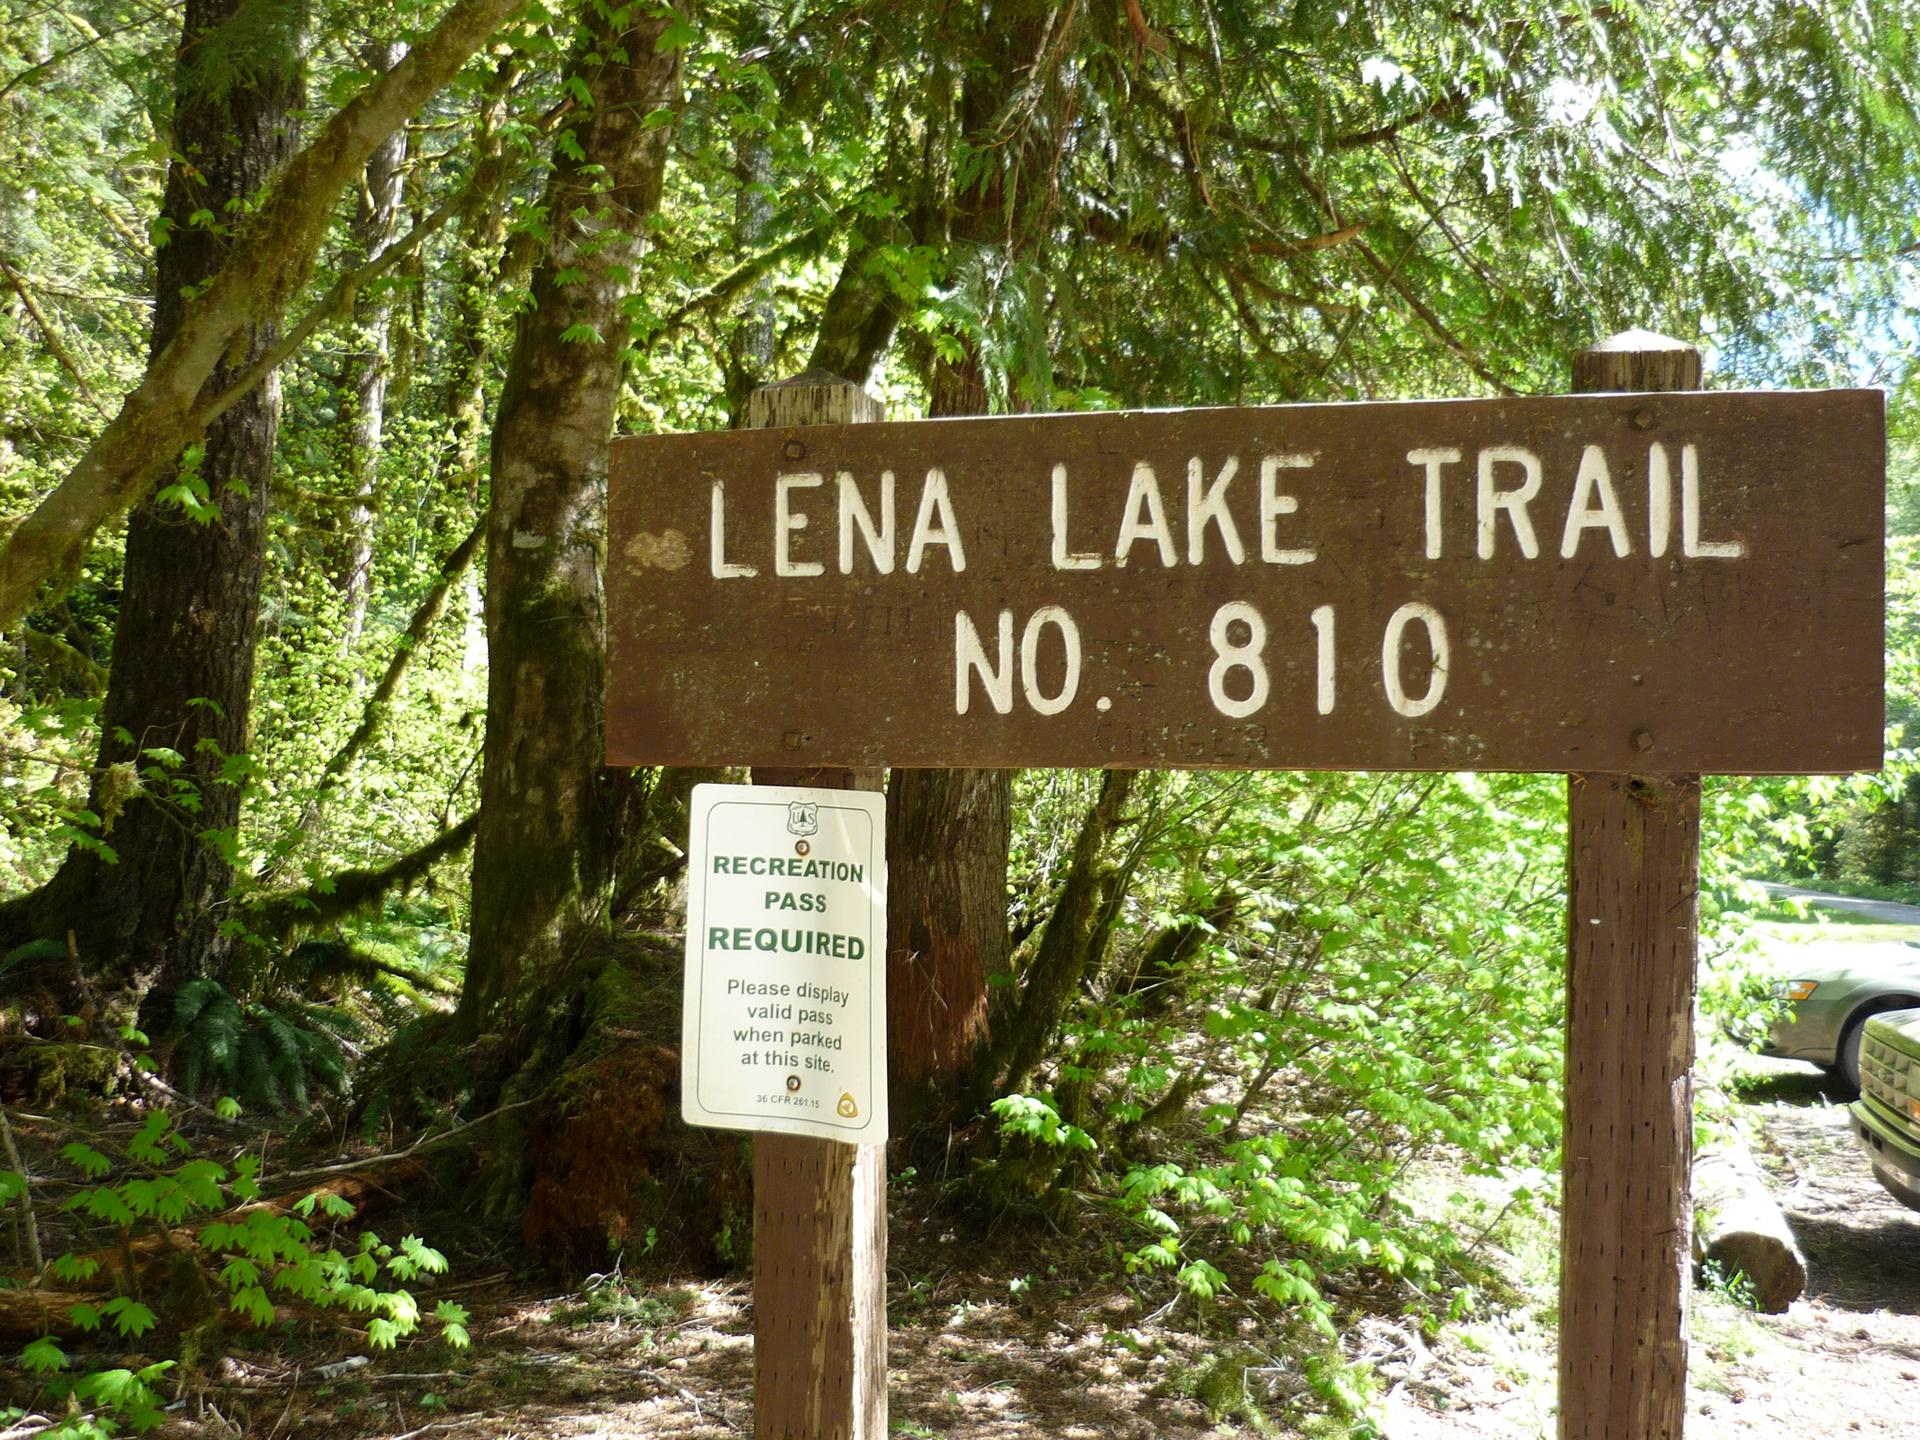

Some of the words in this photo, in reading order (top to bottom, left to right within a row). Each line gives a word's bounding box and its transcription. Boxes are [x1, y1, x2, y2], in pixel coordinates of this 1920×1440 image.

[711, 468, 966, 579] LENA
[1052, 454, 1316, 570] LAKE
[1407, 442, 1744, 560] TRAIL
[955, 606, 1111, 715] NO.
[1208, 601, 1449, 718] 810
[713, 855, 864, 883] RECREATION
[764, 891, 827, 913] PASS
[708, 927, 865, 960] REQUIRED
[727, 979, 790, 997] Please
[796, 981, 849, 1007] display
[747, 1003, 792, 1020] valid
[798, 1009, 833, 1026] pass
[733, 1026, 784, 1043] when
[790, 1028, 842, 1050] parked
[741, 1050, 759, 1066] at
[765, 1050, 799, 1068] this
[804, 1053, 835, 1074] site.
[757, 1094, 768, 1103] 36
[770, 1095, 791, 1104] CFR
